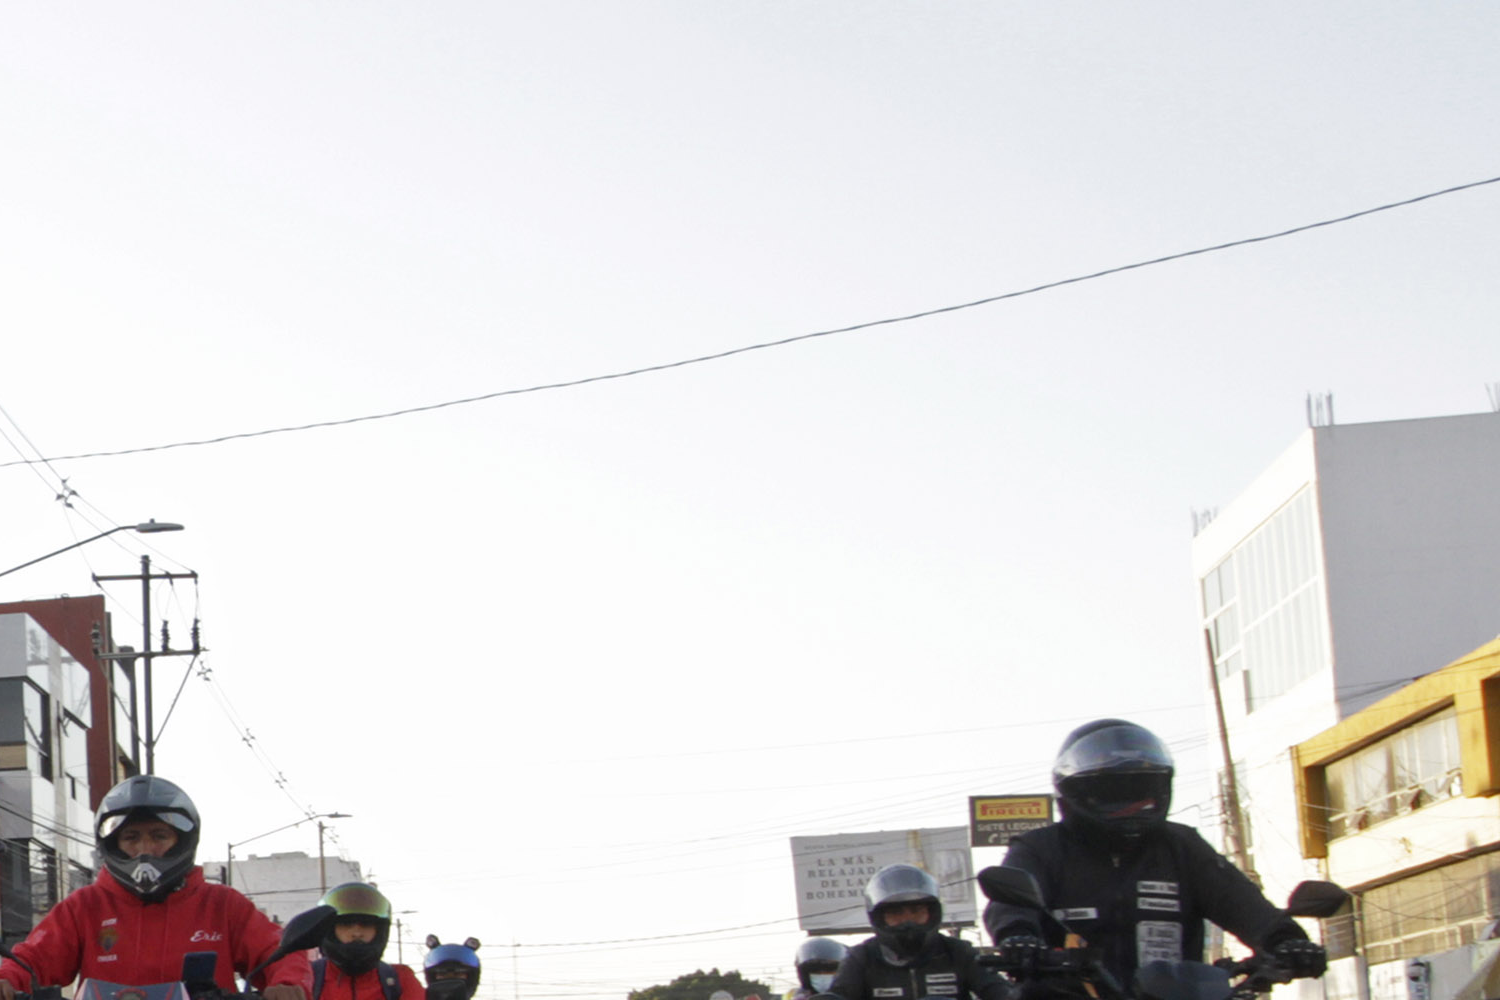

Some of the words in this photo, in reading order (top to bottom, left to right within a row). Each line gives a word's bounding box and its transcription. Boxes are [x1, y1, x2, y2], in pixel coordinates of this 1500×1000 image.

[817, 859, 835, 867] LA
[821, 880, 839, 888] DE
[190, 930, 223, 942] Eric
